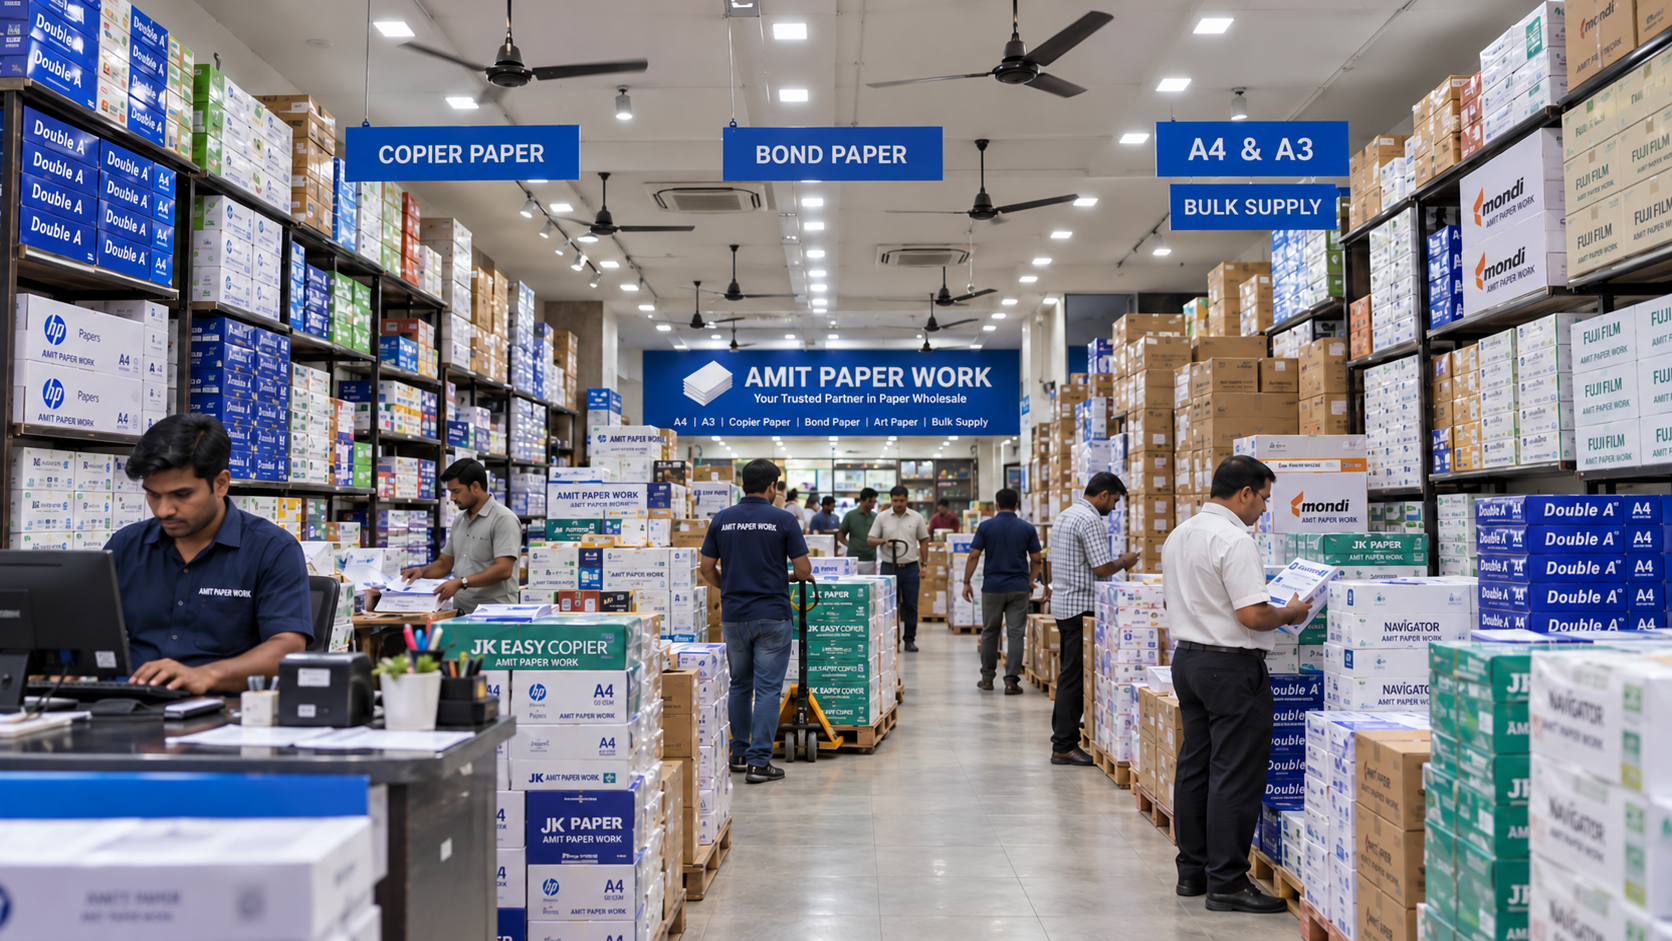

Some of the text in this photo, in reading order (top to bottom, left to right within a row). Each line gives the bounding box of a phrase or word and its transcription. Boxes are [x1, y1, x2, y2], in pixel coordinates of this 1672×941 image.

[1585, 0, 1615, 33] mondi
[34, 49, 71, 82] Double
[34, 120, 85, 155] Double A
[378, 144, 544, 164] COPIER PAPER
[756, 145, 907, 164] BOND PAPER
[1188, 137, 1313, 161] A4 & A3
[1632, 133, 1670, 162] FUJI FILM
[33, 152, 84, 184] Double A
[107, 151, 149, 180] Double A
[159, 172, 169, 187] A4
[32, 183, 83, 215] Double A
[1482, 177, 1524, 216] mondi
[1185, 199, 1321, 215] BULK SUPPLY
[1486, 214, 1499, 228] AMIT
[1635, 205, 1652, 225] FUJI
[30, 216, 82, 245] Double A
[157, 229, 168, 242] A4
[1577, 223, 1612, 249] FUJI FILM
[155, 257, 166, 271] A4
[1484, 247, 1526, 281] mondi
[44, 314, 67, 346] hp
[79, 328, 101, 343] Papers
[1584, 321, 1621, 345] FUJI FILM
[1652, 335, 1668, 347] AMIT
[42, 350, 57, 360] AMIT
[119, 353, 130, 366] A4
[1580, 355, 1594, 365] AMIT
[1612, 345, 1628, 357] WORK
[745, 366, 992, 388] AMIT PAPER WORK
[42, 378, 64, 410] hp
[1585, 377, 1622, 398] FUJI FILM
[77, 390, 100, 403] Papers
[754, 393, 967, 406] Your Trusted Partner in Paper Wholesale
[1654, 393, 1669, 404] AMIT
[38, 413, 54, 422] AMIT
[118, 412, 128, 425] A4
[674, 417, 988, 428] A4 A3 Copier Paper Bond Paper Art Paper Bulk Supply
[610, 435, 625, 443] AMIT
[1588, 433, 1625, 451] FUJI FILM
[1653, 447, 1668, 458] AMIT
[556, 491, 639, 500] AMIT PAPER WORK
[1302, 499, 1349, 513] mondi
[1479, 503, 1499, 517] Double
[1544, 502, 1614, 517] Double A
[1633, 502, 1651, 515] A4
[737, 523, 757, 531] PAPER
[758, 523, 777, 532] WORK
[1352, 540, 1402, 549] JK PAPER
[1545, 531, 1615, 546] Double A
[1634, 531, 1652, 544] A4
[1546, 560, 1617, 575] Double A
[1635, 560, 1653, 572] A4
[199, 587, 213, 598] AMIT
[214, 588, 233, 598] PAPER
[1547, 589, 1618, 604] Double A
[1636, 588, 1654, 601] A4
[1548, 618, 1619, 631] Double A
[1637, 618, 1656, 630] A4
[471, 639, 608, 655] JK EASY COPIER
[495, 658, 579, 667] AMIT PAPER WORK
[529, 683, 547, 701] hp
[594, 683, 614, 698] A4
[1309, 683, 1318, 695] A
[599, 737, 616, 749] A4
[528, 773, 544, 783] JK
[1265, 783, 1305, 795] Double
[540, 817, 623, 833] JK PAPER
[542, 836, 564, 844] AMIT
[596, 835, 622, 843] WORK
[542, 878, 559, 896] hp
[604, 879, 624, 893] A4
